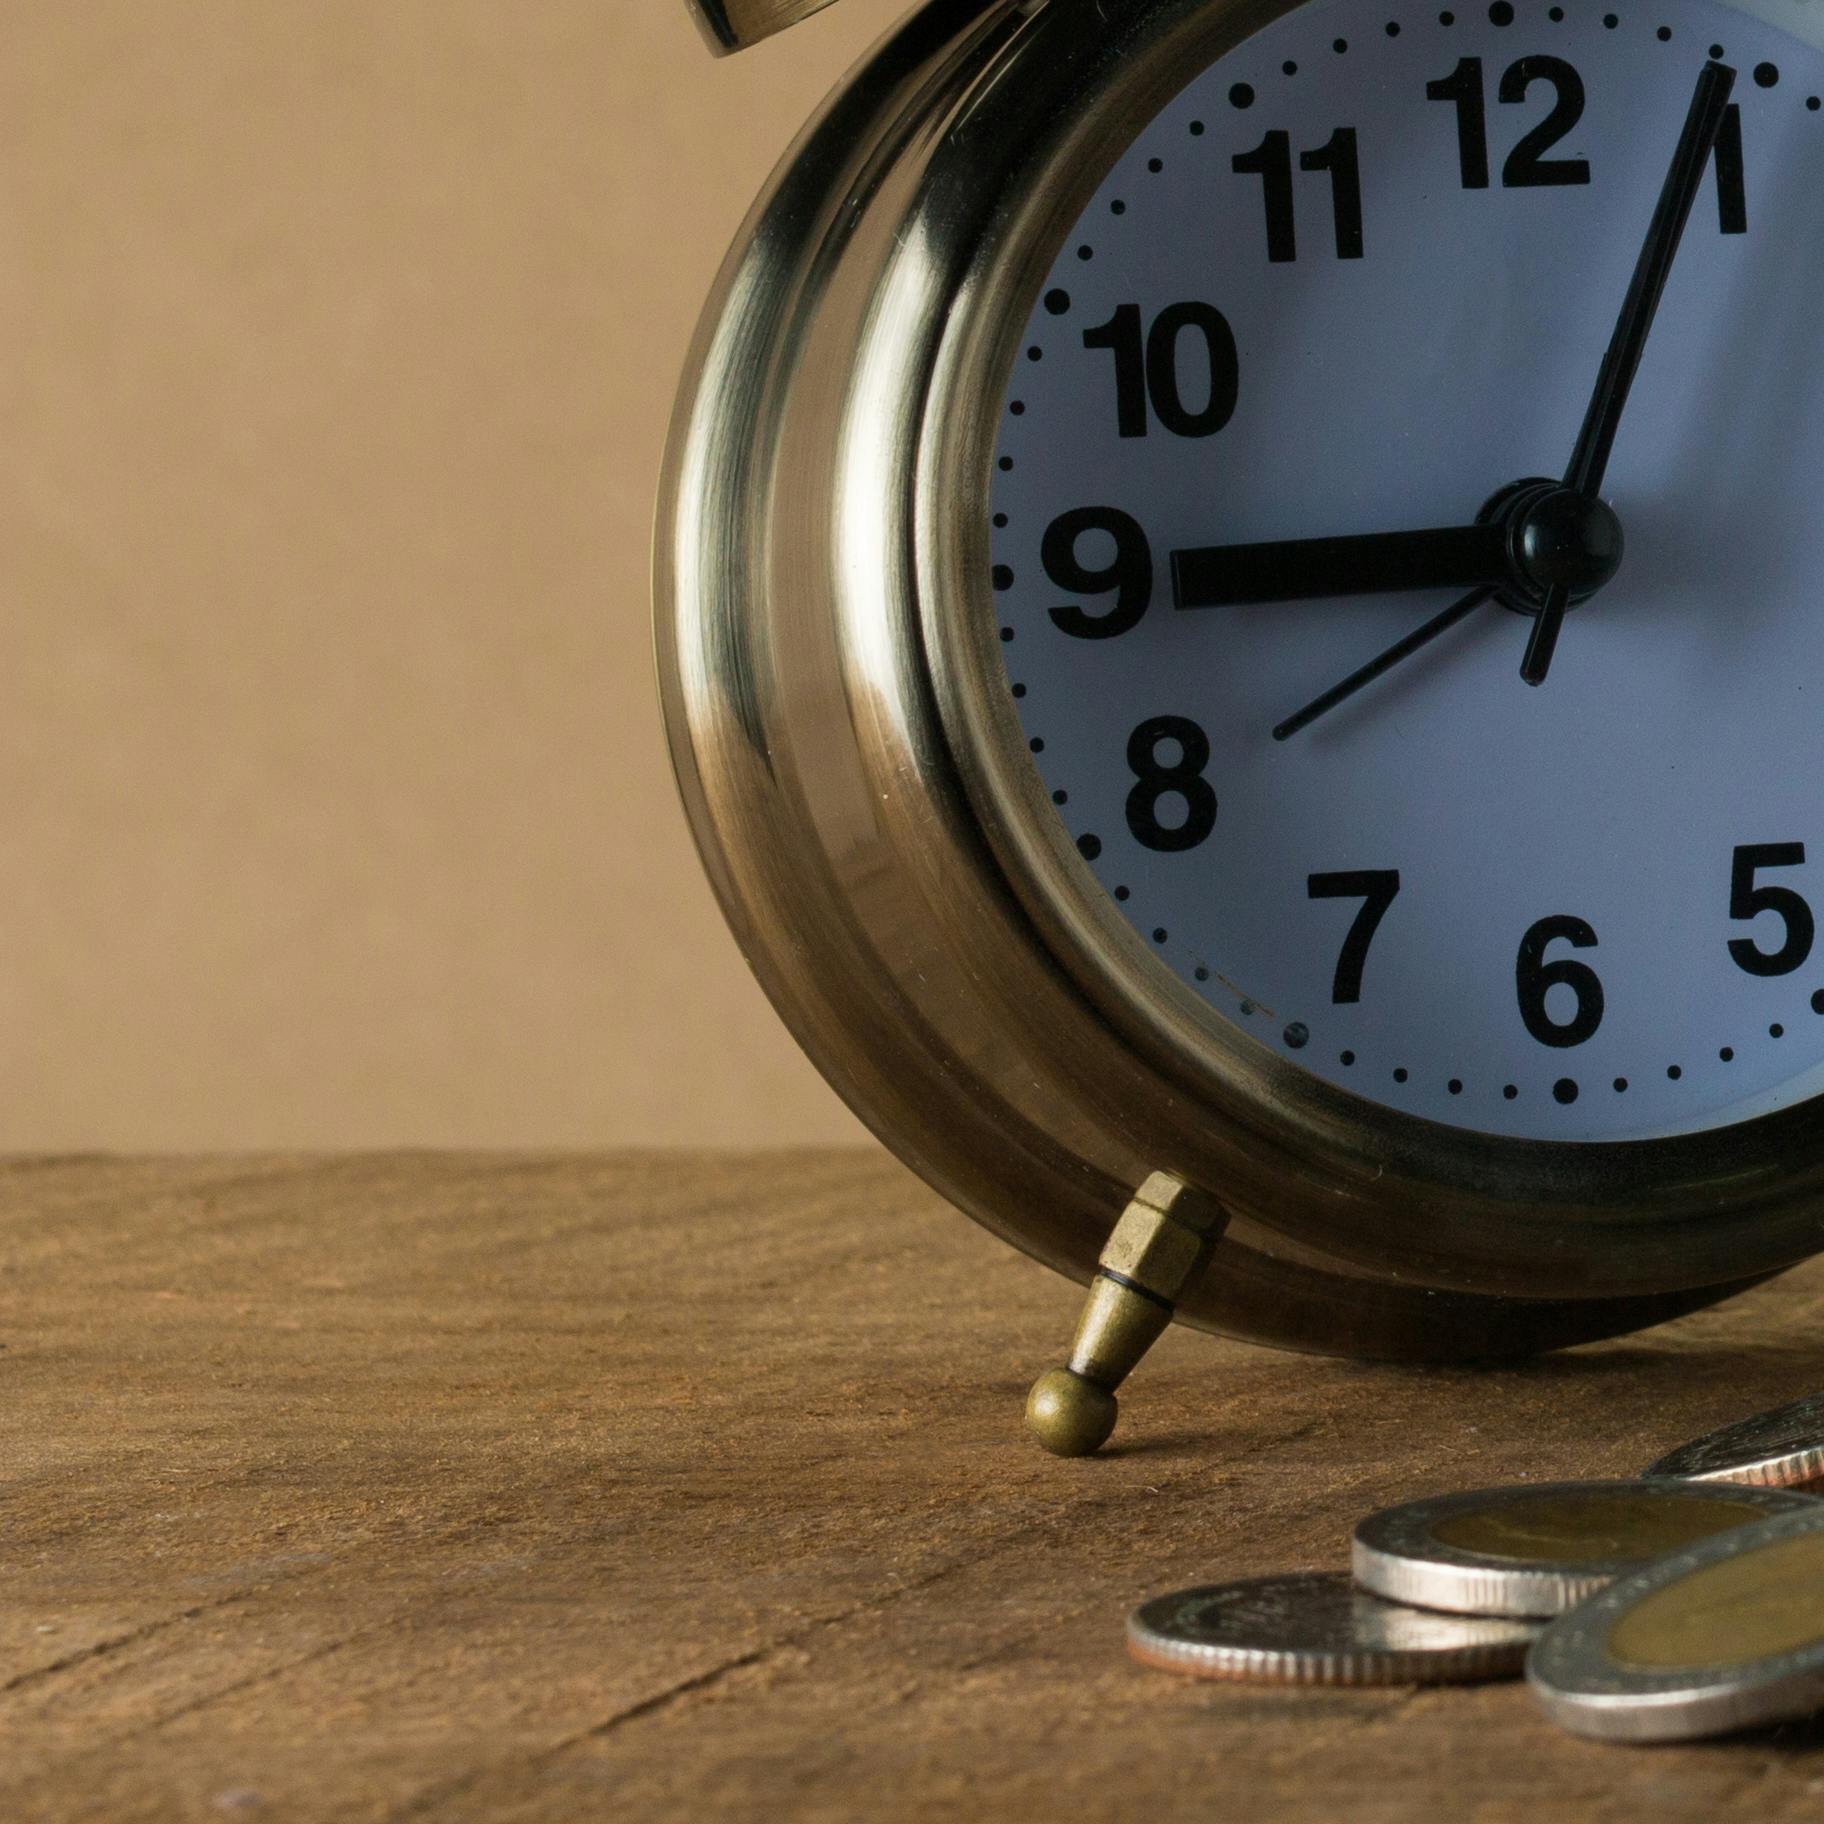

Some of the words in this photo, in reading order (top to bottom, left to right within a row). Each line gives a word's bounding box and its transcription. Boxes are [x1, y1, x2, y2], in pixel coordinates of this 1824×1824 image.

[1425, 54, 1591, 189] 12
[1711, 104, 1747, 234] 1
[1230, 127, 1364, 262] 11
[1082, 302, 1240, 438] 10
[1040, 507, 1153, 639] 9
[1125, 715, 1219, 852] 8
[1307, 869, 1401, 1004] 7
[1727, 842, 1815, 976] 5
[1515, 915, 1605, 1048] 6
